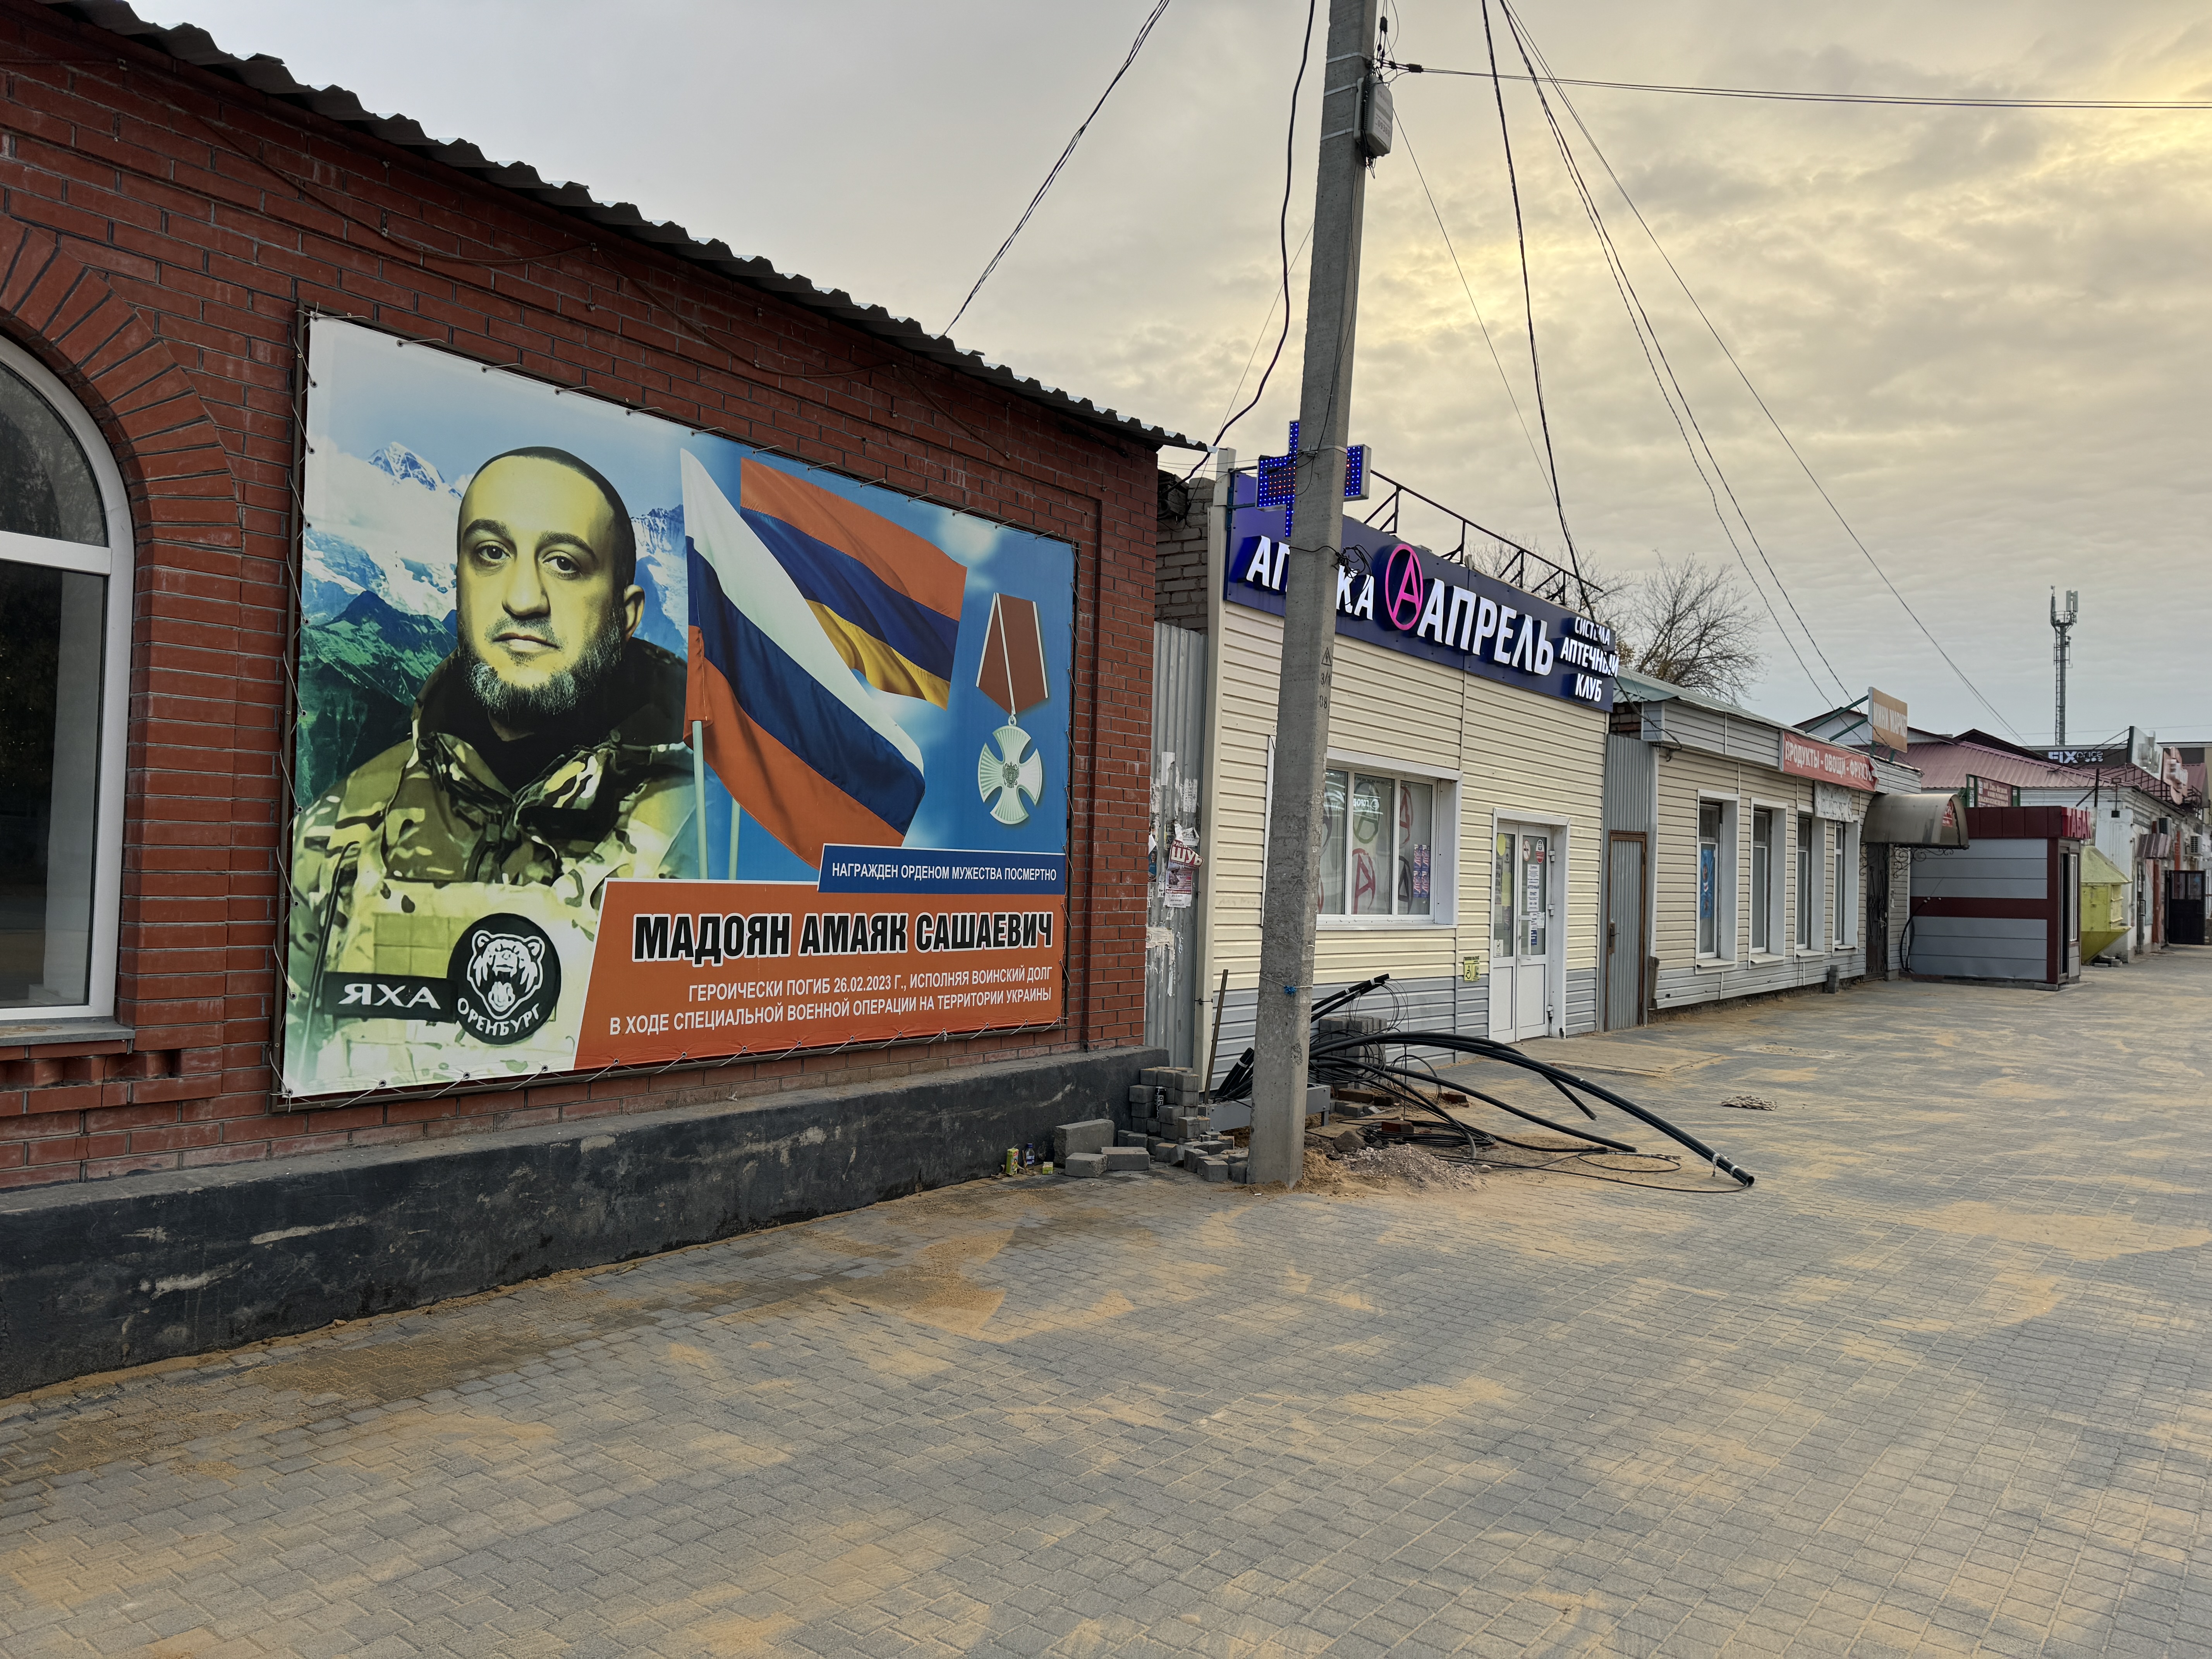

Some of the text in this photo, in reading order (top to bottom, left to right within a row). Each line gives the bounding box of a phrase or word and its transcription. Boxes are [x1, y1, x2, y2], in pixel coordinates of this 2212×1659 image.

[1246, 536, 1374, 620] АПКА
[1417, 578, 1553, 675] АПРЕЛЬ
[1575, 617, 1610, 646] СИСТЕМА
[1560, 637, 1620, 678] АПТЕЧНЫЙ
[1575, 673, 1602, 702] КЛУБ
[1873, 701, 1889, 731] МИНИ
[1785, 740, 1819, 769] ПРОДУКТЫ
[1825, 753, 1846, 778] ОВОЩИ
[2048, 751, 2078, 764] FIX
[832, 862, 1057, 881] НАГРАЖДЕН ОРДЕНОМ МУЖЕСТВА ПОСМЕРТНО
[633, 912, 1053, 966] МАДОЯН АМАЯК САШАЕВИЧ
[338, 983, 441, 1010] ЯХА
[689, 981, 783, 1002] ГЕРОИЧЕСКИ
[787, 978, 831, 996] ПОГИБ
[834, 975, 891, 993] 26.02.2023
[910, 971, 969, 988] ИСПОЛНЯЯ
[972, 964, 1025, 985] ВОИНСКИЙ
[1027, 967, 1053, 983] ДОЛГ
[457, 997, 539, 1036] ОРЕНБУРГ
[610, 987, 1052, 1036] В ХОДЕ СПЕЦИАЛЬНОЙ ВОЕННОЙ ОПЕРАЦИИ НА ТЕРРИТОРИИ УКРАИНЫ
